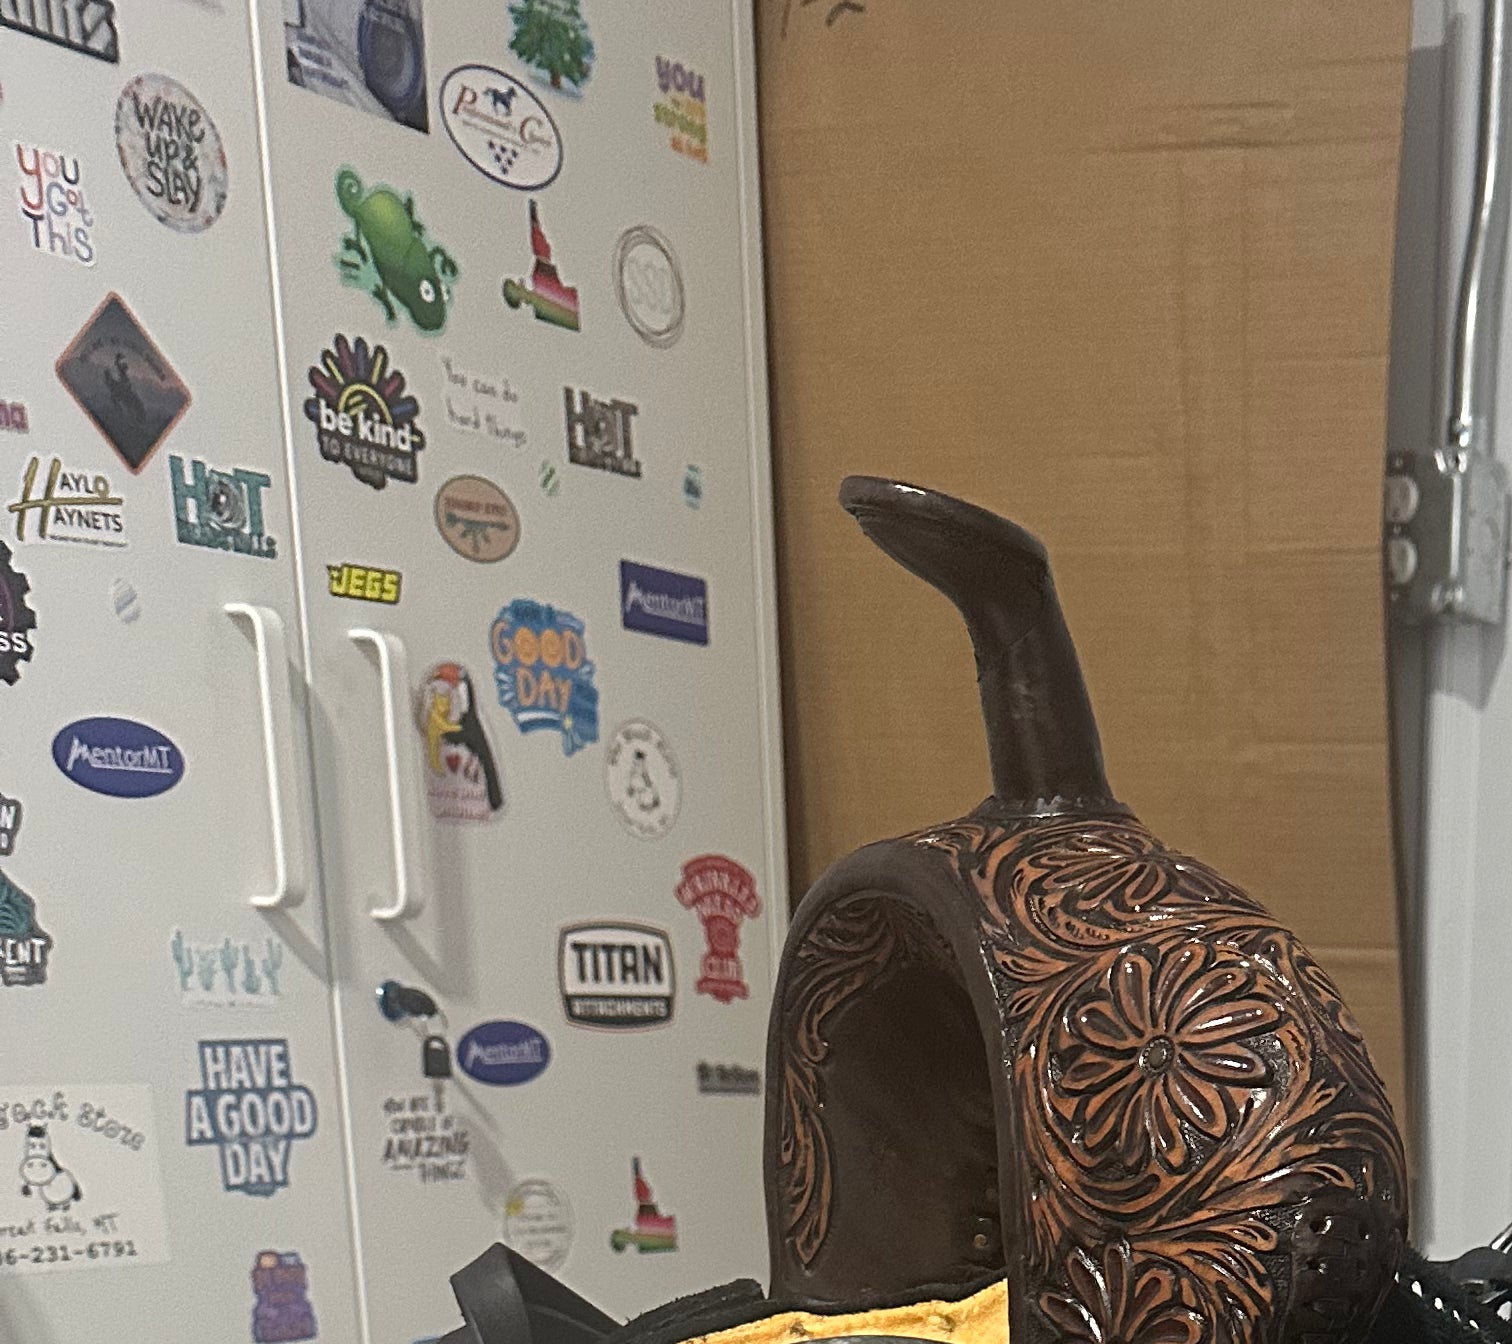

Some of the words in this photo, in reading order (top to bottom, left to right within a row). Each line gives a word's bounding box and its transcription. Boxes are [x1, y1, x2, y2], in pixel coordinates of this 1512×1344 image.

[319, 400, 353, 436] be
[357, 411, 412, 452] kind
[331, 567, 398, 602] JEGS
[491, 619, 585, 670] GOOD
[515, 668, 572, 713] DAY
[571, 942, 662, 984] TITAN
[203, 1044, 290, 1090] HAVE
[190, 1095, 214, 1139] A
[216, 1090, 313, 1138] GOOD
[225, 1141, 288, 1184] DAY
